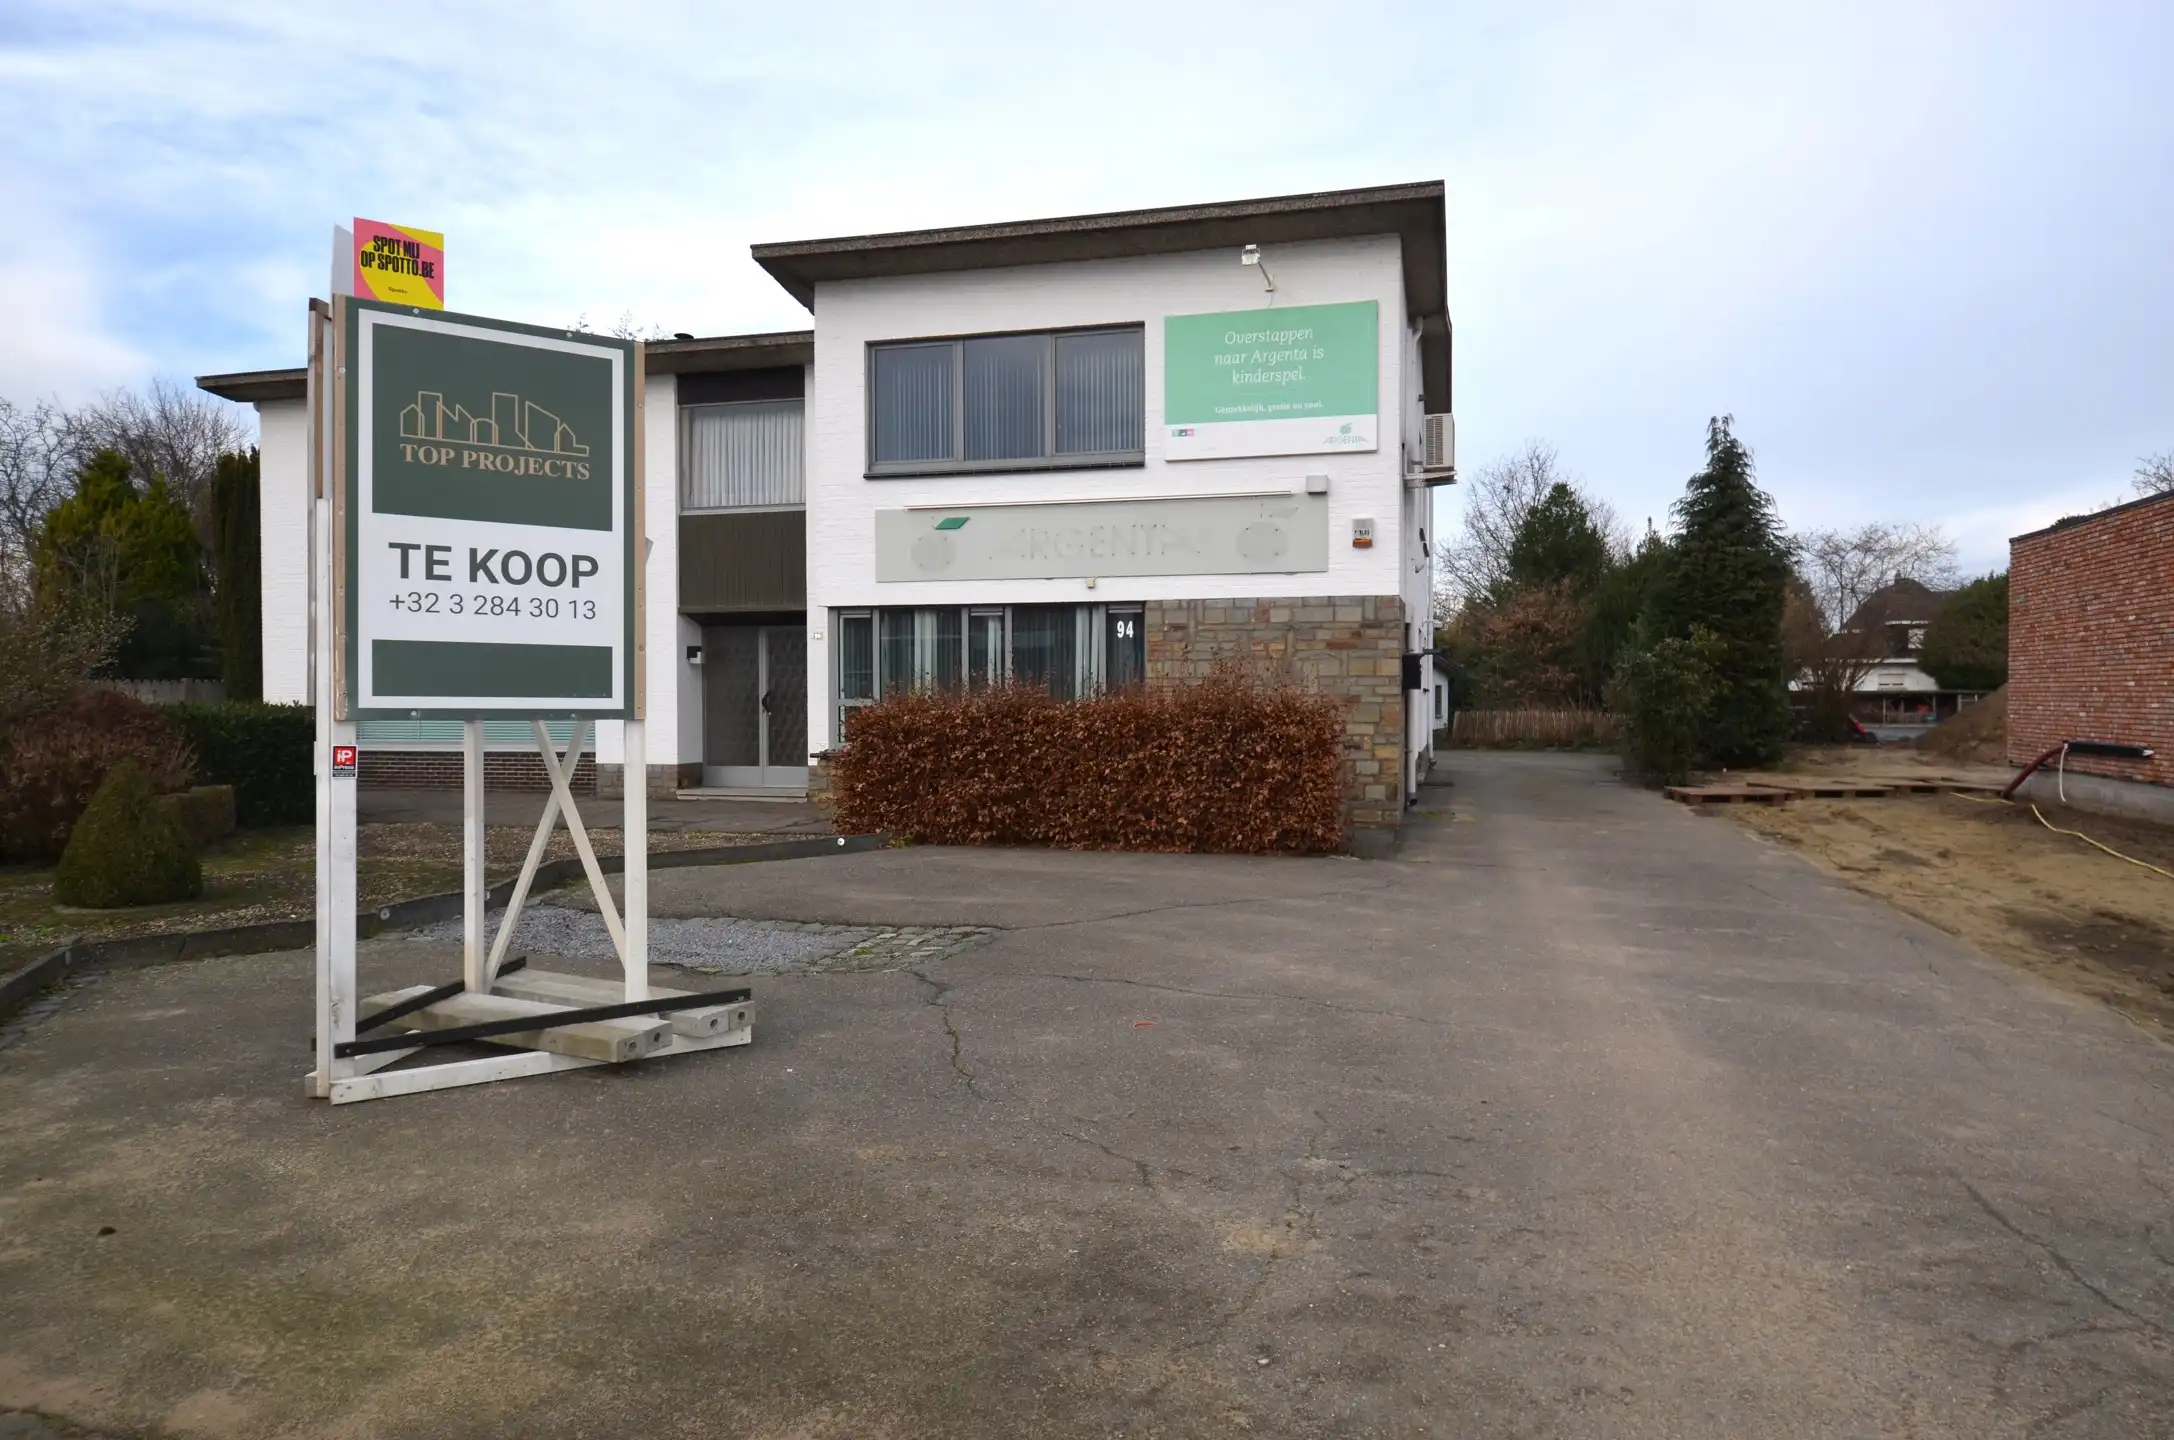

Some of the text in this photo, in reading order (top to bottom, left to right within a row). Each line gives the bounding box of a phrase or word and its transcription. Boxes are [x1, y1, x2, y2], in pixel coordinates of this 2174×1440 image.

[373, 235, 420, 259] SPOT MIJ
[360, 250, 435, 279] OP SPOTTO.BE
[1224, 328, 1314, 345] Overstappen
[1213, 345, 1324, 366] naar Argenta is
[1232, 365, 1306, 386] kinderspel.
[400, 443, 591, 480] TOP PROJECTS
[388, 542, 599, 589] TE KOOP
[389, 591, 596, 620] +32 3 284 30 13
[1117, 620, 1134, 638] 94
